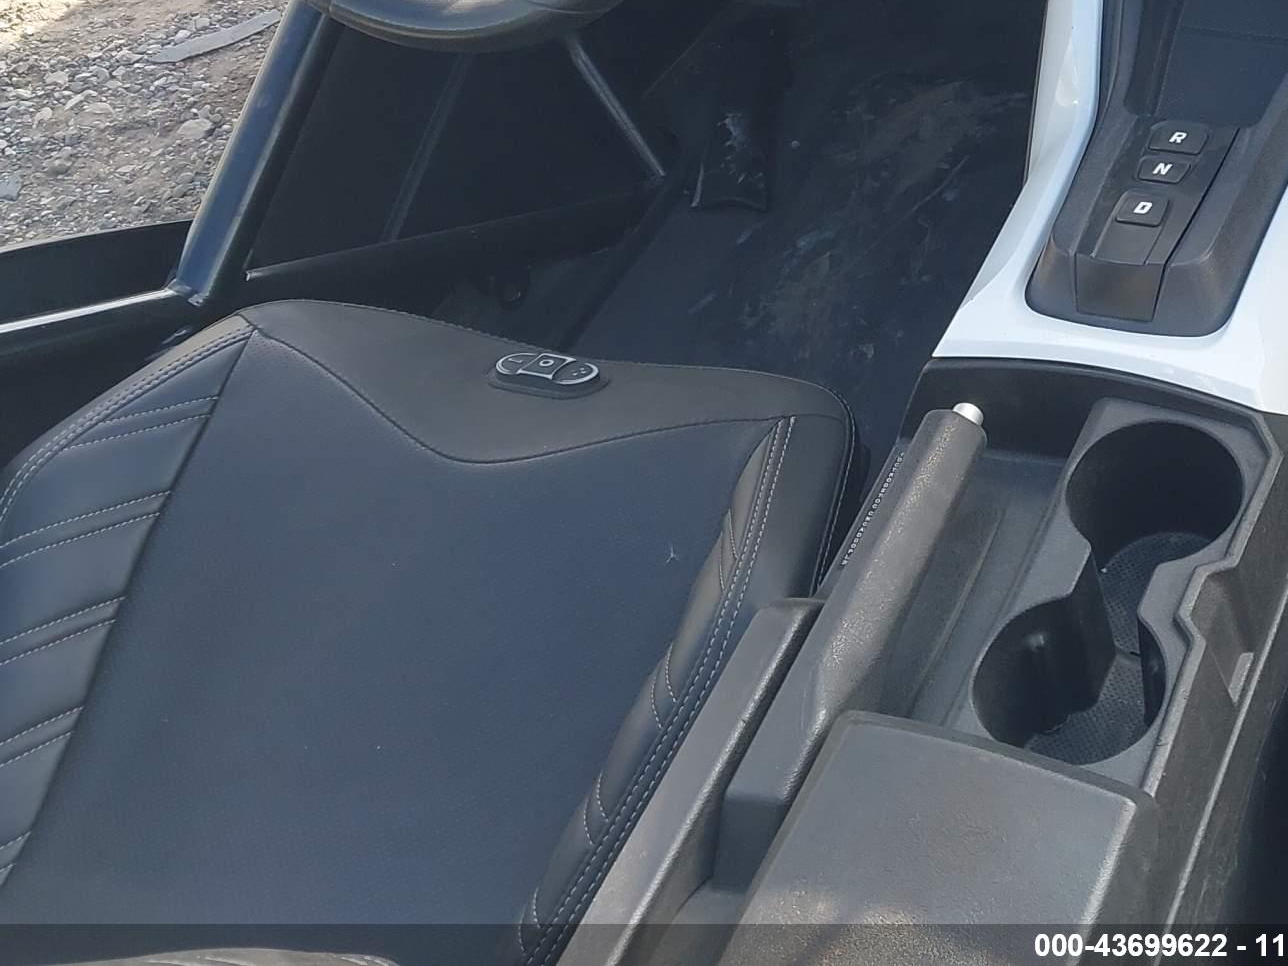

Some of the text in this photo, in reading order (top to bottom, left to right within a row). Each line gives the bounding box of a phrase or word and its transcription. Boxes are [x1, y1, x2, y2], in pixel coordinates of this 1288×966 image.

[1168, 131, 1188, 144] R
[1152, 162, 1173, 175] N
[1133, 201, 1153, 214] D
